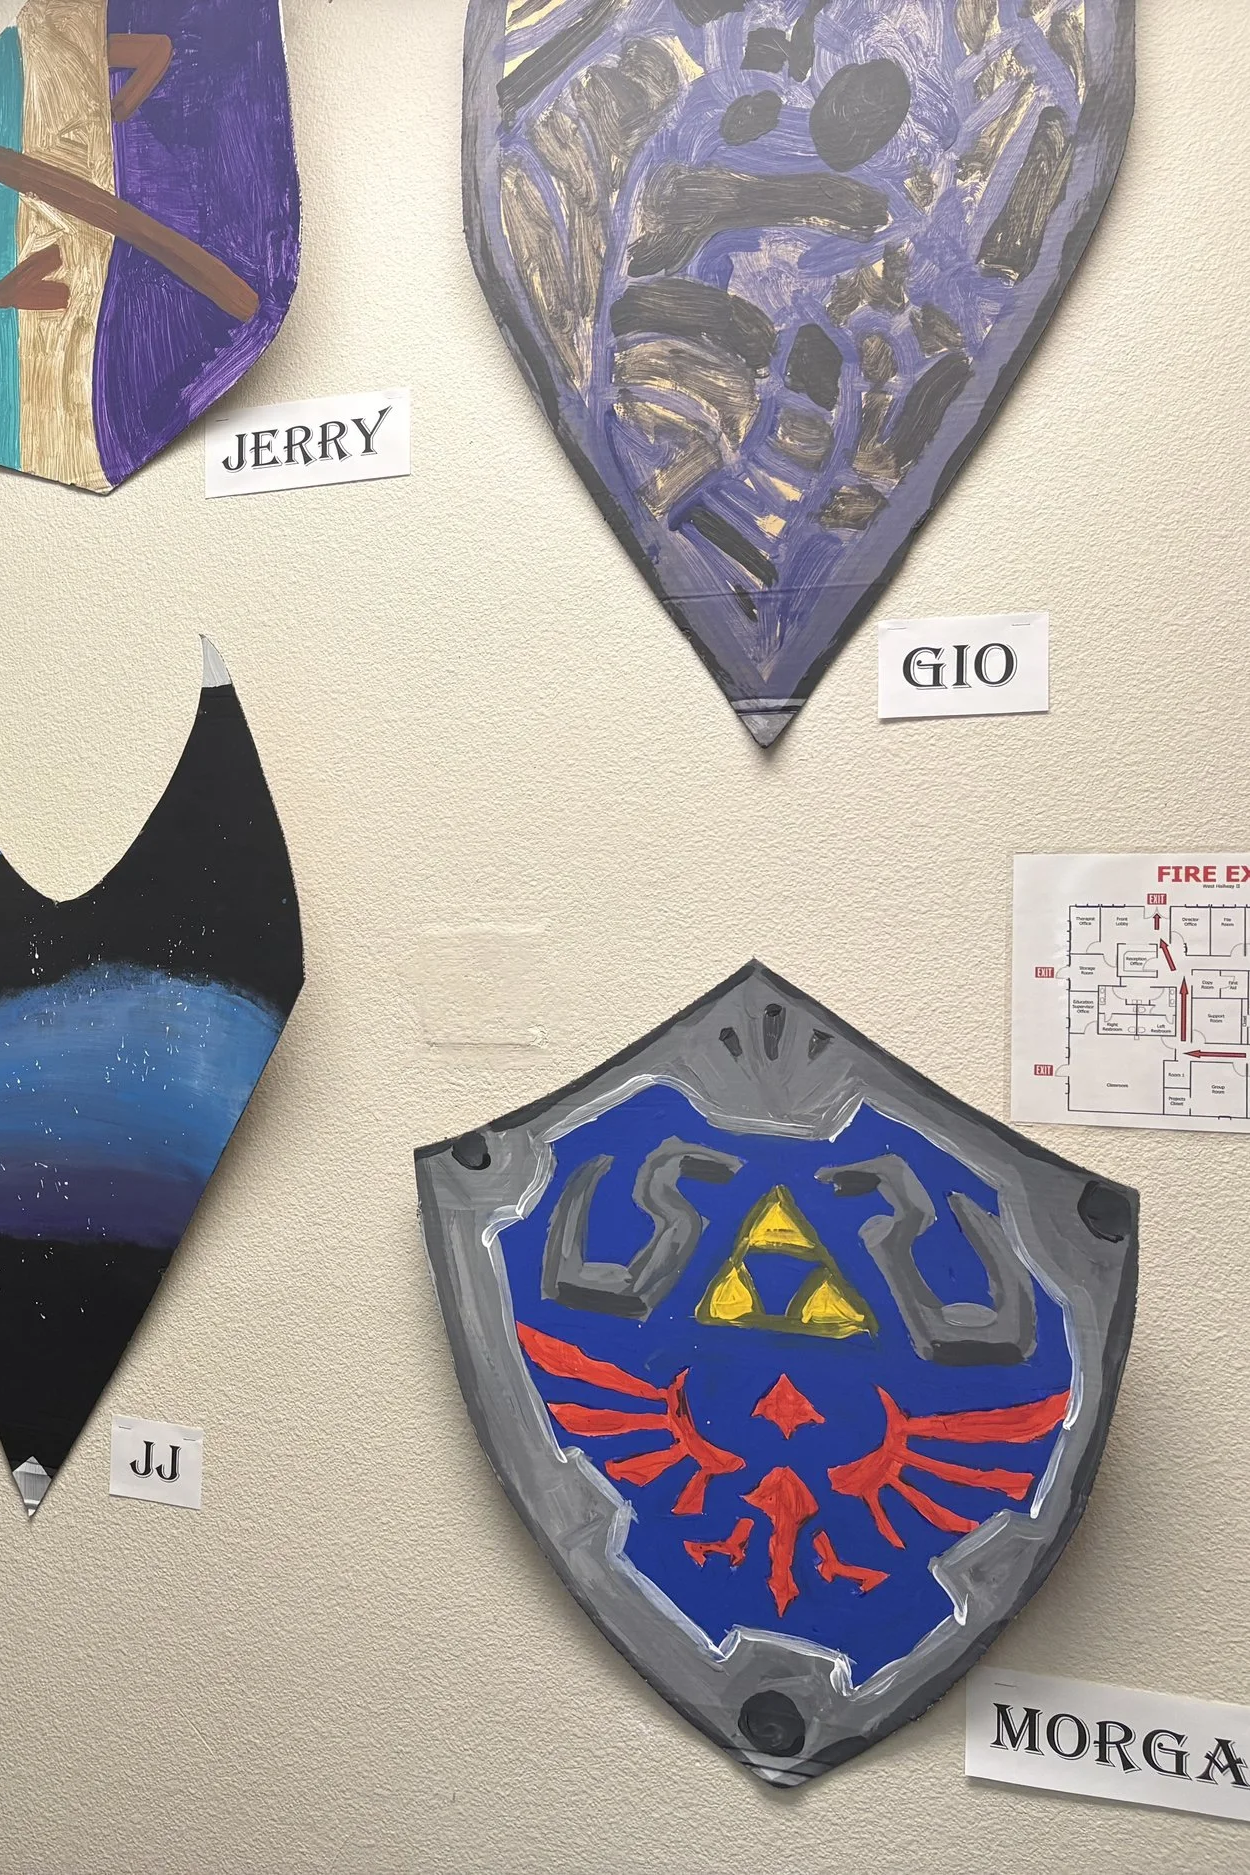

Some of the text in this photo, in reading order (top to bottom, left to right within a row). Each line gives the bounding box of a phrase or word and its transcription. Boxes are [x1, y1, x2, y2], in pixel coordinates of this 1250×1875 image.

[222, 405, 393, 473] JERRY
[903, 643, 1018, 690] GIO
[1157, 865, 1217, 883] FIRE
[1149, 894, 1164, 904] EXIT
[1037, 968, 1052, 977] EXIT
[1036, 1065, 1052, 1075] EXIT
[130, 1440, 181, 1484] JJ
[990, 1702, 1250, 1790] MORGA
